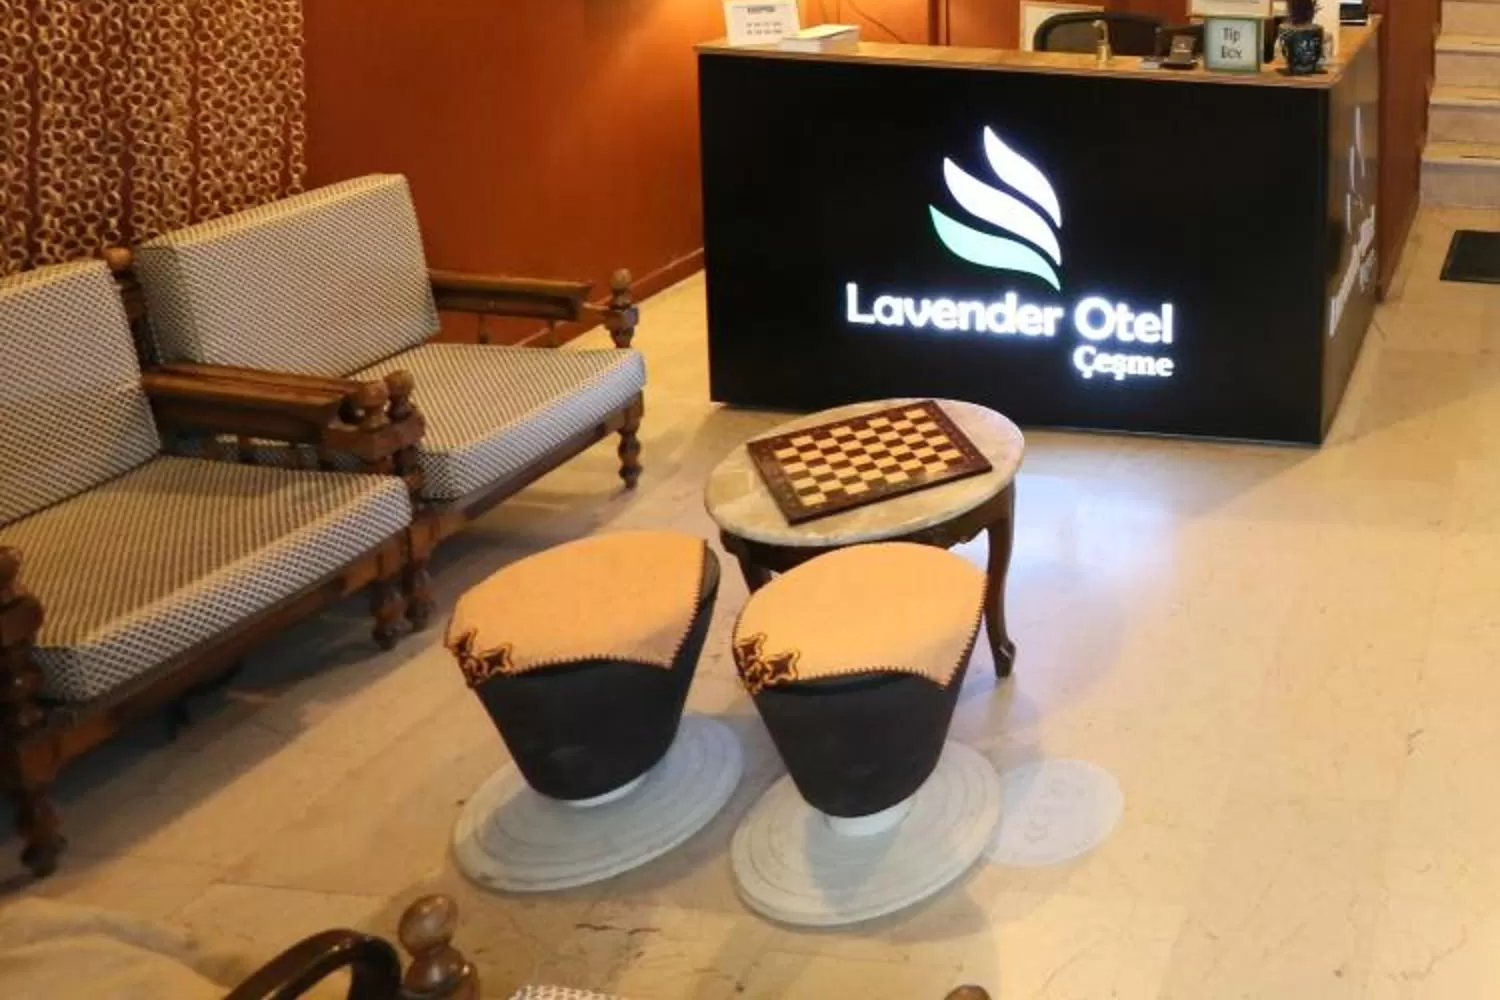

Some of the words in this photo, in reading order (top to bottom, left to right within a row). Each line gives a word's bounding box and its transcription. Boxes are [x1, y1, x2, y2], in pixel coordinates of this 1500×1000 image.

[1222, 27, 1241, 43] Tip
[845, 281, 1064, 337] Lavender
[1073, 296, 1174, 344] Otel
[1072, 345, 1175, 381] Çeşme
